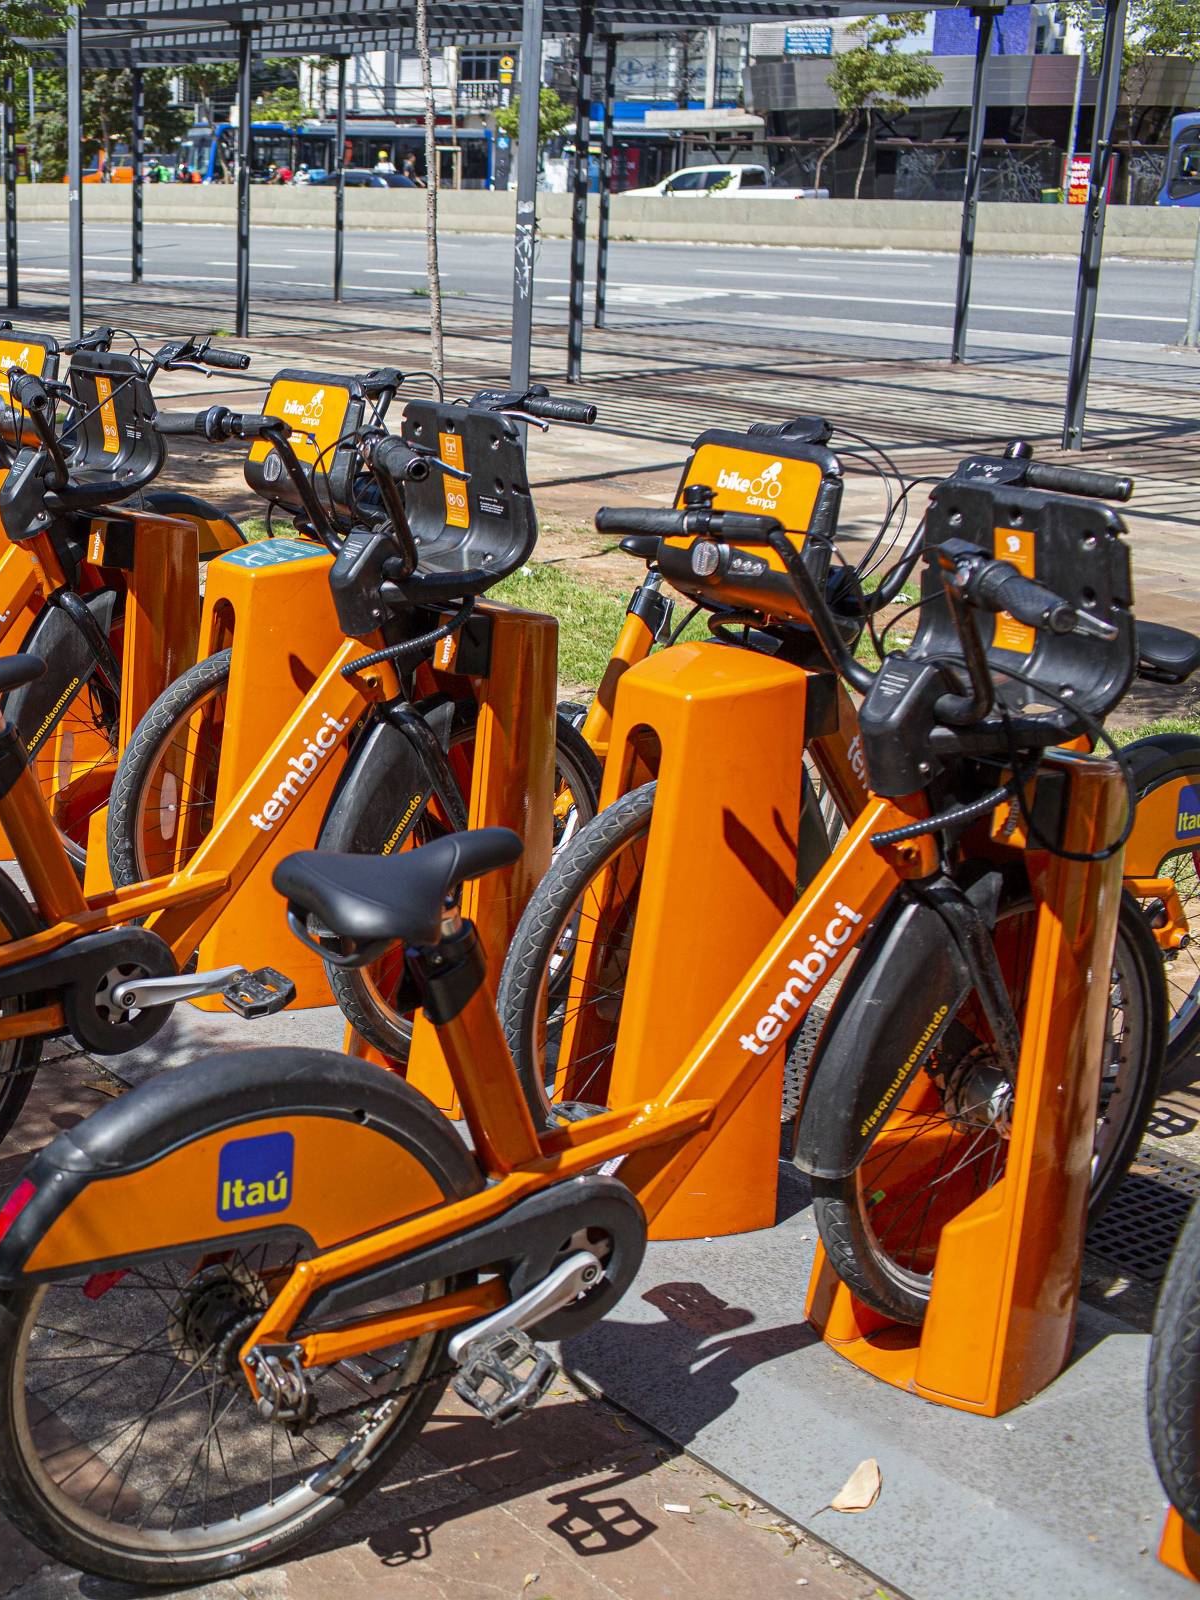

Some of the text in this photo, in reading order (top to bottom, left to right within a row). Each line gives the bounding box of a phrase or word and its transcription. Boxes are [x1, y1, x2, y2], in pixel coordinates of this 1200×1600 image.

[283, 400, 305, 416] bike
[716, 469, 751, 492] bike
[745, 495, 778, 511] sampa
[738, 901, 864, 1055] tembici
[221, 1171, 288, 1211] Itaú
